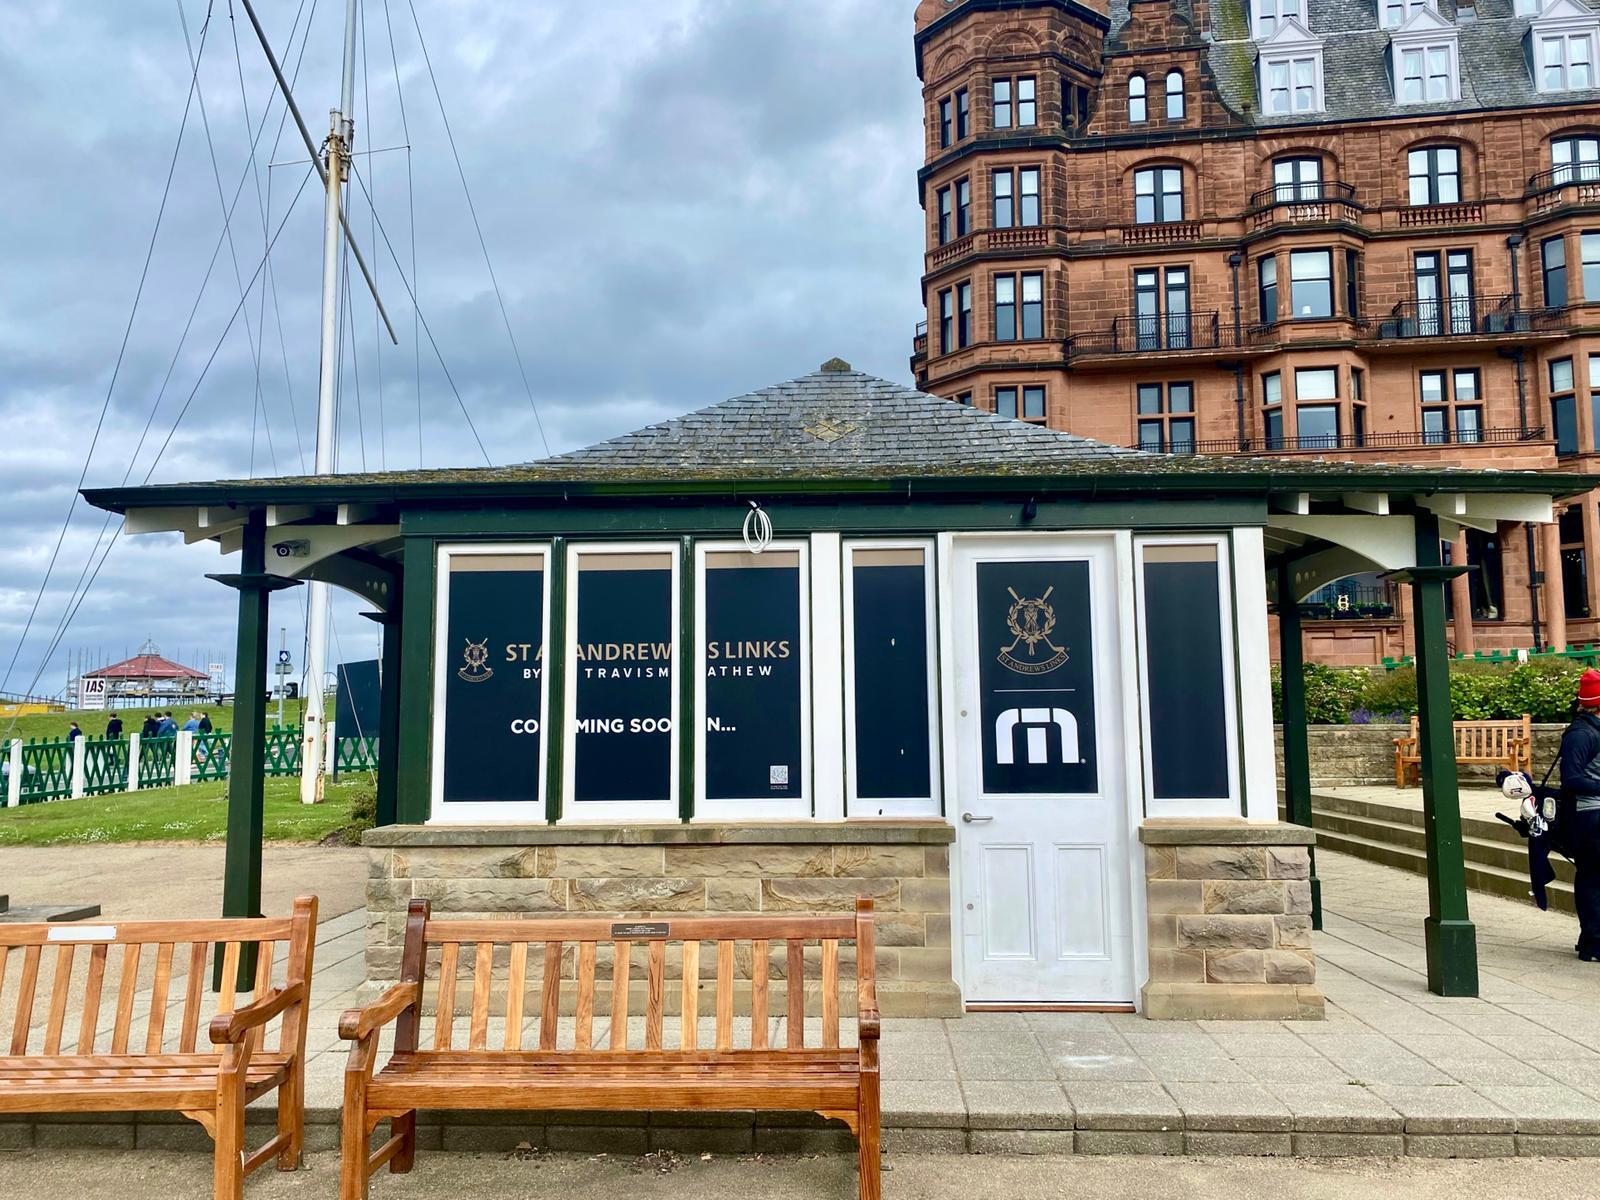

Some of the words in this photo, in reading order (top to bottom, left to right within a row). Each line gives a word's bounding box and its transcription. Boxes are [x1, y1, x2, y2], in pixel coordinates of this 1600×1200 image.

[505, 644, 531, 661] ST
[725, 641, 790, 658] LINKS
[523, 668, 541, 679] BY
[85, 680, 105, 693] IAS
